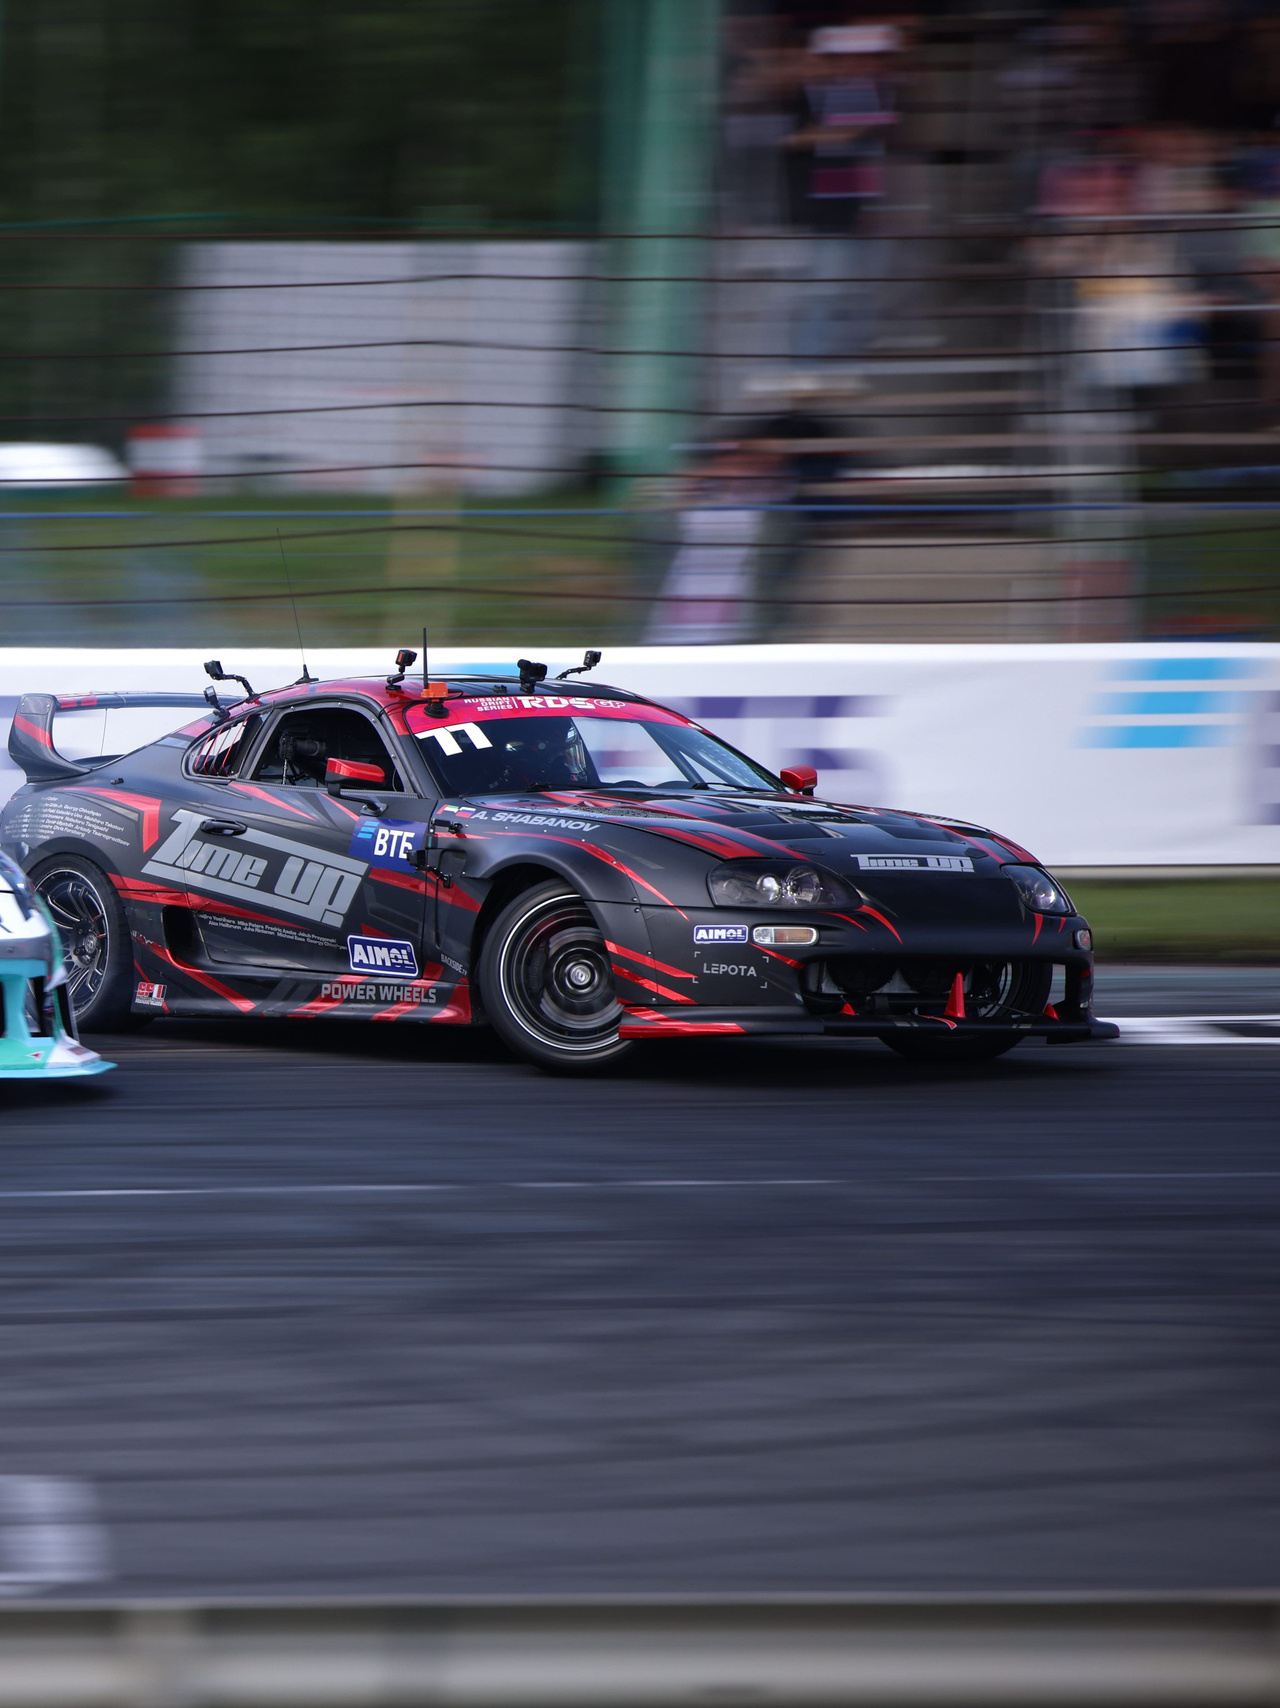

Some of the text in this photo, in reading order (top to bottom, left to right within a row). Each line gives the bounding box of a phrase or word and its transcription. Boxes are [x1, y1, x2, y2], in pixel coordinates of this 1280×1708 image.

[463, 696, 510, 704] RUSSIAN
[516, 695, 596, 709] RDS
[476, 704, 514, 712] SERIES
[471, 810, 601, 832] A. SHABANOV
[696, 928, 745, 941] AIMOL
[353, 943, 415, 969] AIMOL
[703, 962, 758, 978] LEPOTA
[321, 983, 437, 1004] POWER WHEELS
